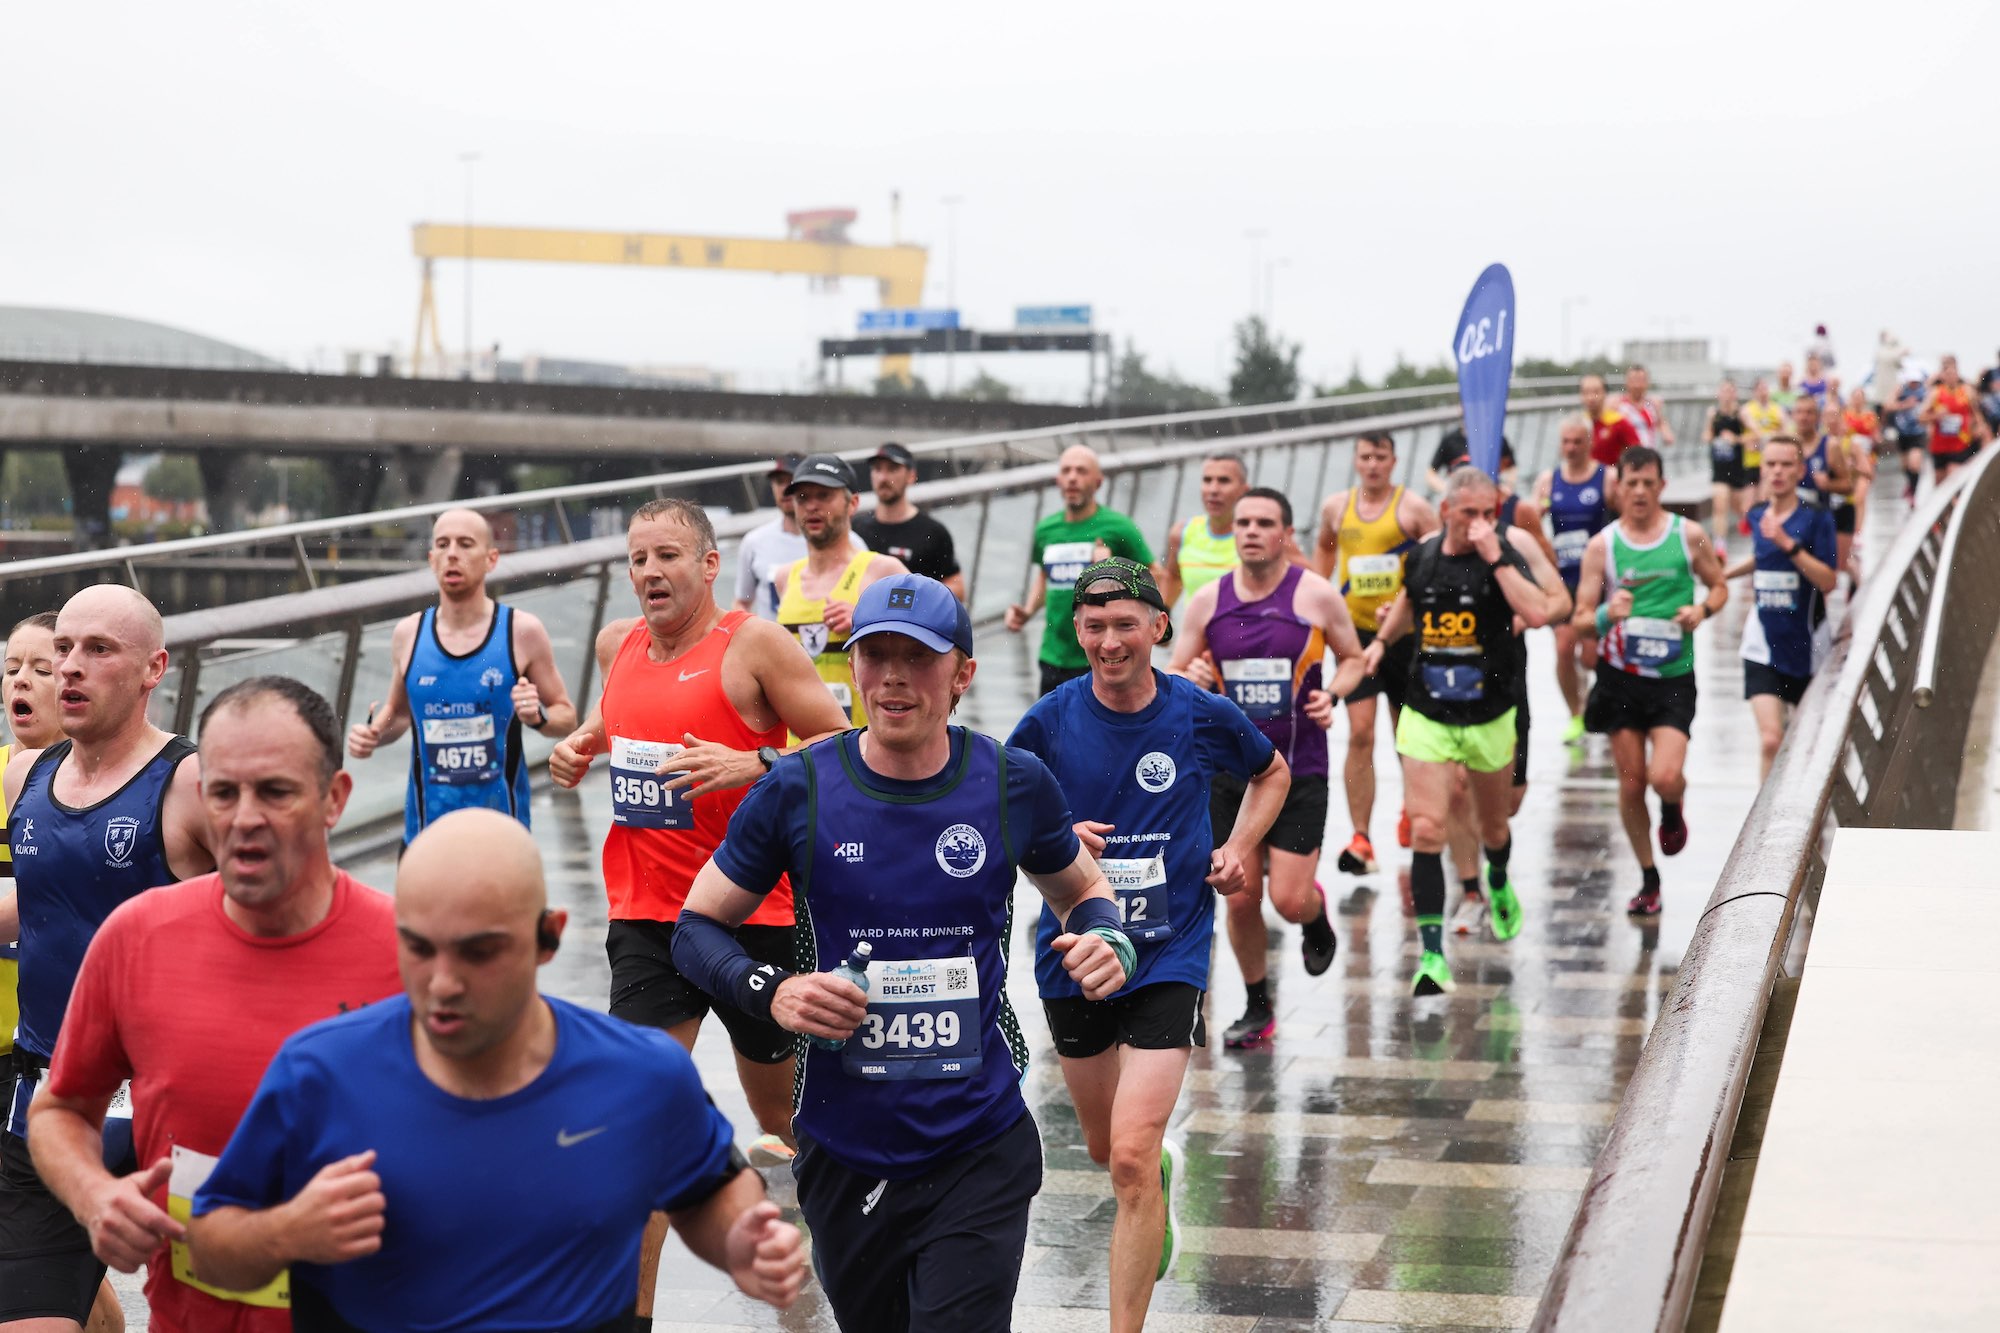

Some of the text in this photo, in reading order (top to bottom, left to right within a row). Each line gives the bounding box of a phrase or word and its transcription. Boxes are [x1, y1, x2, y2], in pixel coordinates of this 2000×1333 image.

[1444, 668, 1456, 688] 1
[1234, 684, 1281, 704] 1355
[436, 745, 488, 769] 4675
[626, 757, 659, 767] BELFAST
[614, 775, 673, 807] 3591
[107, 816, 140, 826] SAINTFIELD
[1105, 832, 1171, 844] PARK RUNNERS
[15, 844, 38, 855] KUKRI
[105, 859, 133, 869] STRIDERS
[949, 867, 975, 876] BANGOR
[1108, 876, 1141, 884] ELFAST
[1117, 896, 1148, 924] 12
[849, 926, 975, 938] WARD PARK RUNNERS
[883, 984, 936, 994] BELFAST
[861, 1011, 961, 1049] 3439
[861, 1066, 887, 1074] MEDAL
[942, 1063, 960, 1071] 3439
